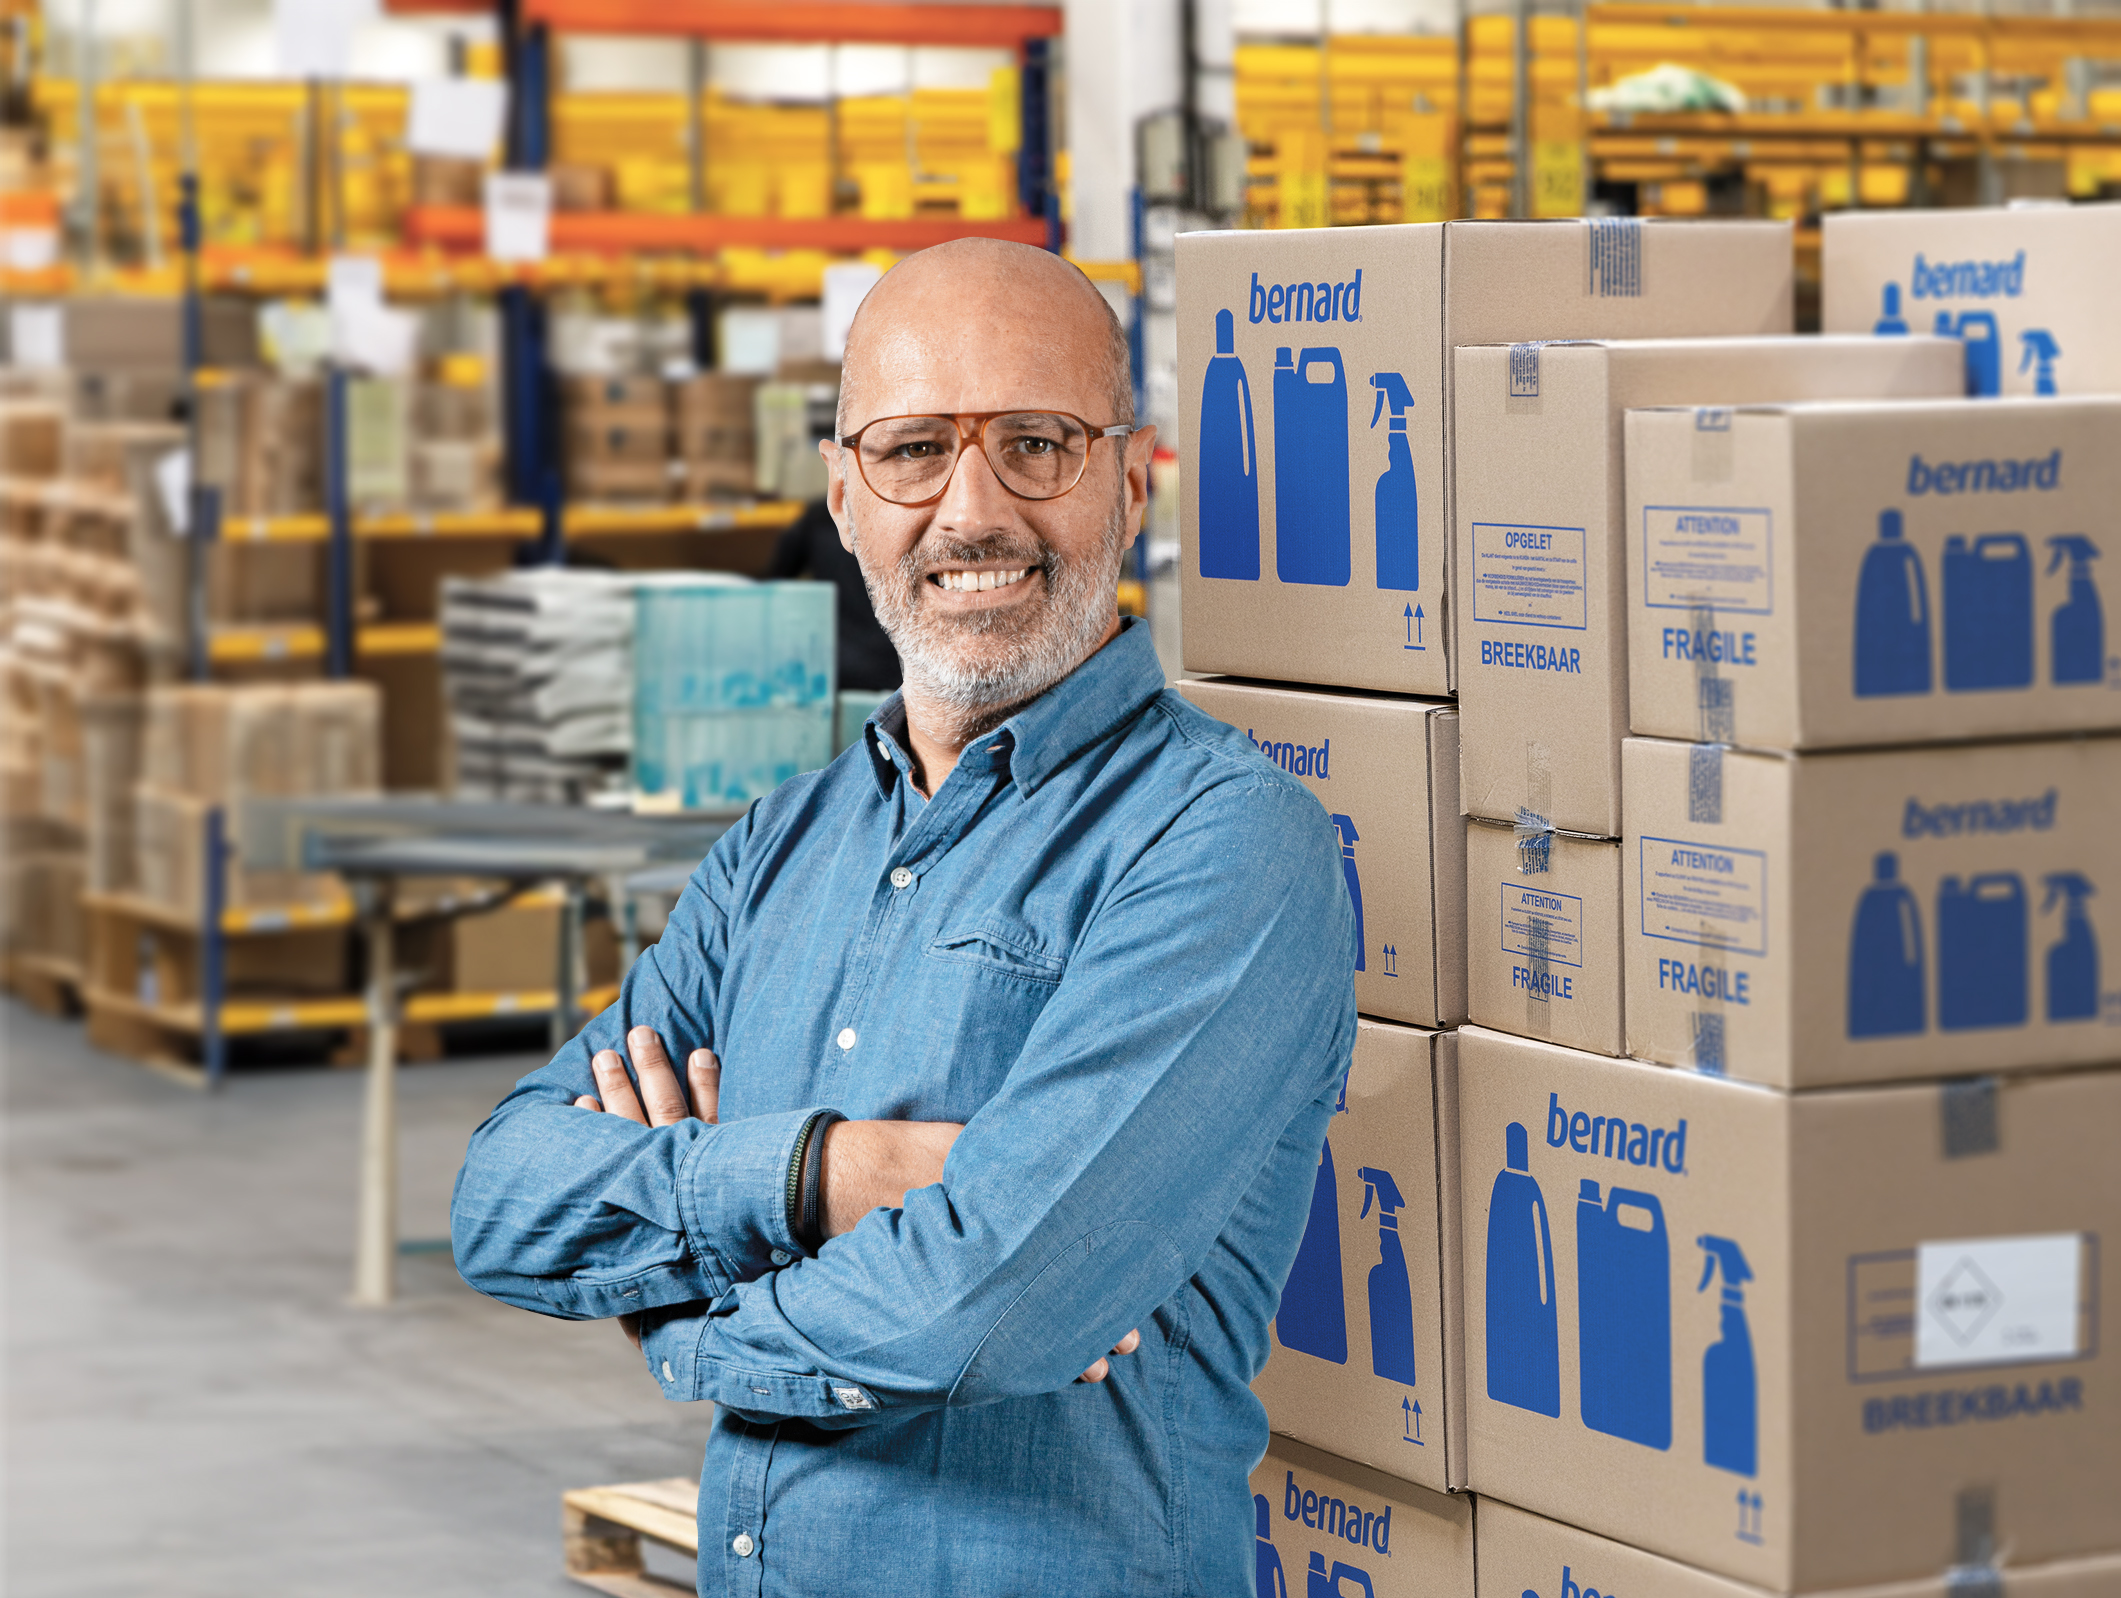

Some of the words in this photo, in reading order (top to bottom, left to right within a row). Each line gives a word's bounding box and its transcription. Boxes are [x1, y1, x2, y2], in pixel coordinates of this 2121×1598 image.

[1249, 269, 1363, 323] bernard
[1911, 249, 2025, 299] bernard
[1906, 449, 2061, 495] bernard
[1505, 532, 1552, 550] OPGELET
[1675, 515, 1740, 535] ATTENTION
[1481, 640, 1581, 674] BREEKBAAR
[1662, 627, 1757, 666] FRAGILE
[1902, 789, 2057, 838] bernard
[1671, 849, 1735, 874] ATTENTION
[1521, 892, 1562, 911] ATTENTION
[1512, 966, 1573, 1000] FRAGILE
[1658, 957, 1750, 1005] FRAGILE
[1547, 1093, 1687, 1174] bernard
[1862, 1377, 2083, 1433] BREEKBAAR
[1284, 1470, 1391, 1555] bernard
